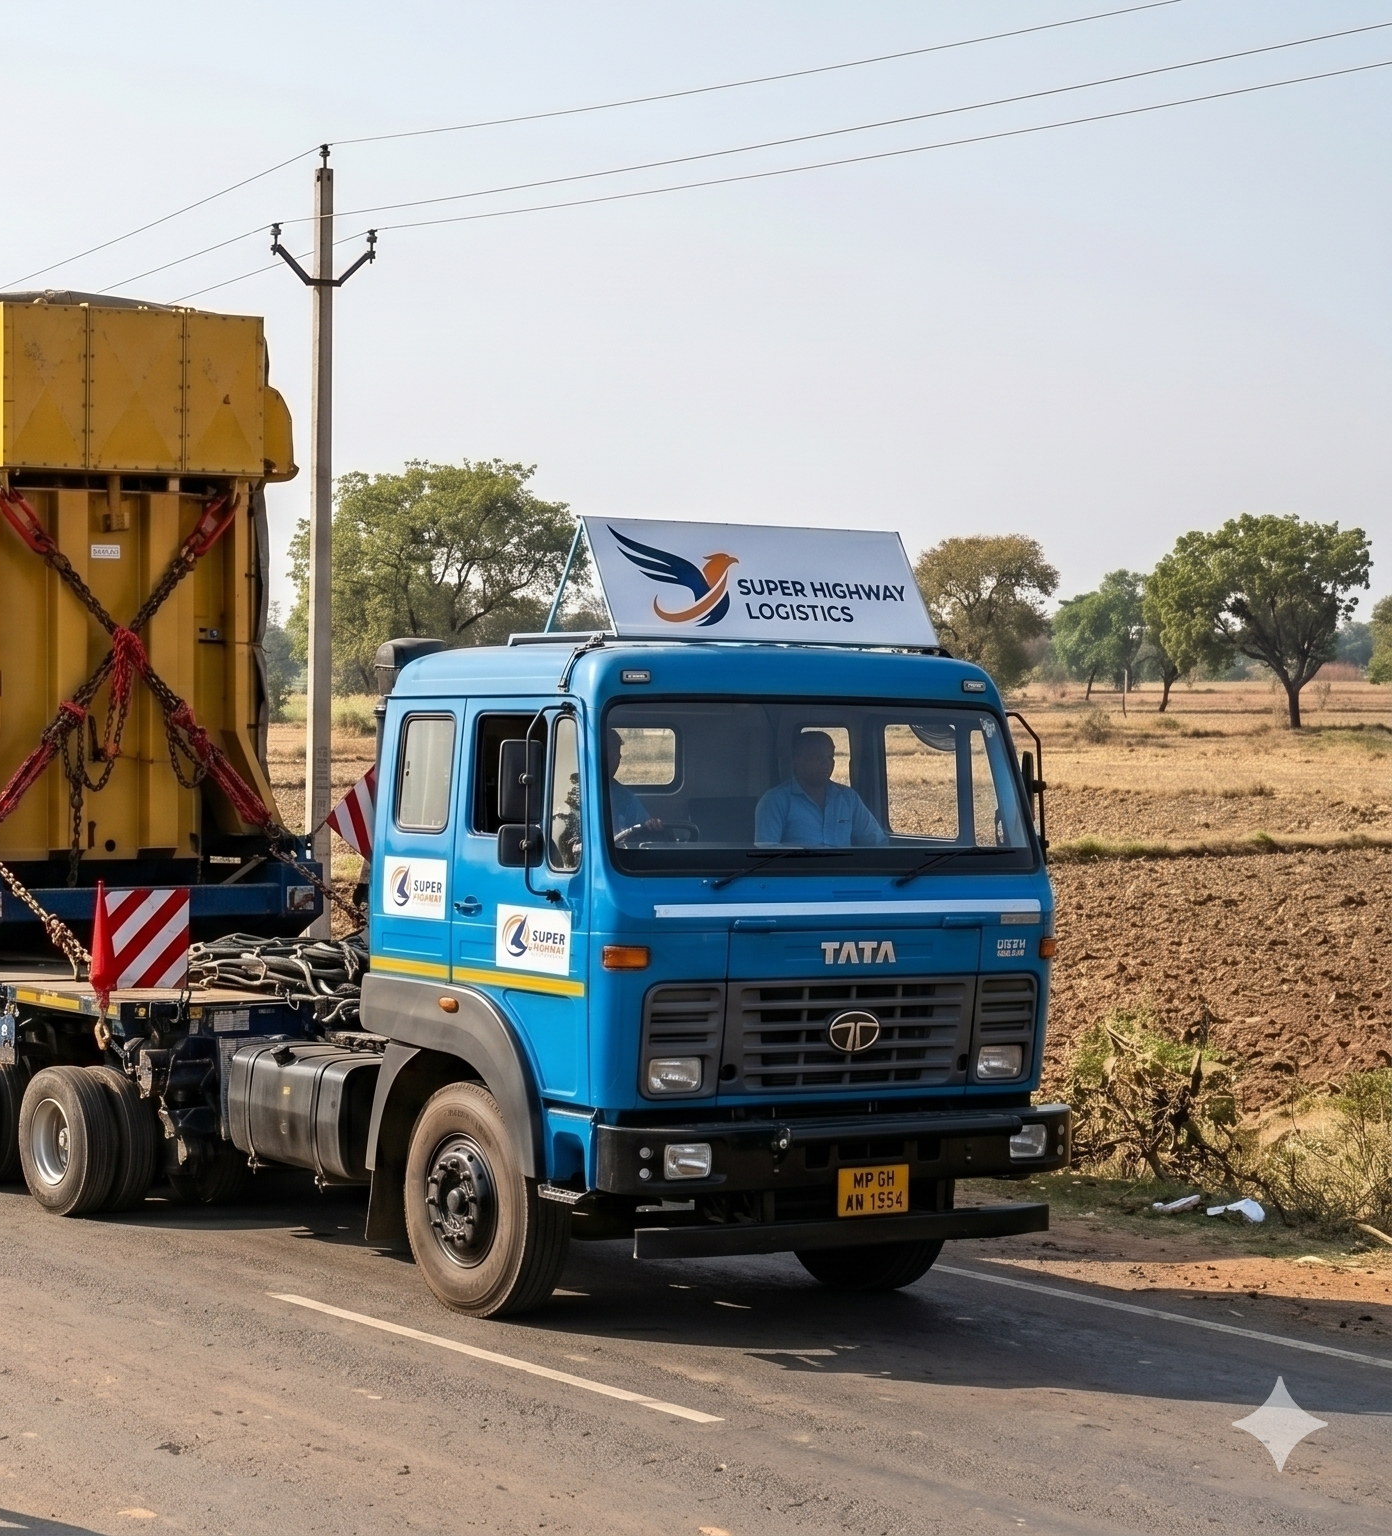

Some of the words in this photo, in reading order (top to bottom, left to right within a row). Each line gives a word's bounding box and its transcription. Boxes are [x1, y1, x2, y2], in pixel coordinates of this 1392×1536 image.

[737, 578, 808, 597] SUPER
[810, 580, 905, 602] HIGHWAY
[745, 603, 854, 623] LOGISTICS
[413, 879, 443, 893] SUPER
[532, 930, 566, 946] SUPER
[820, 940, 897, 965] TATA
[853, 1172, 874, 1189] MP
[877, 1170, 895, 1188] GH
